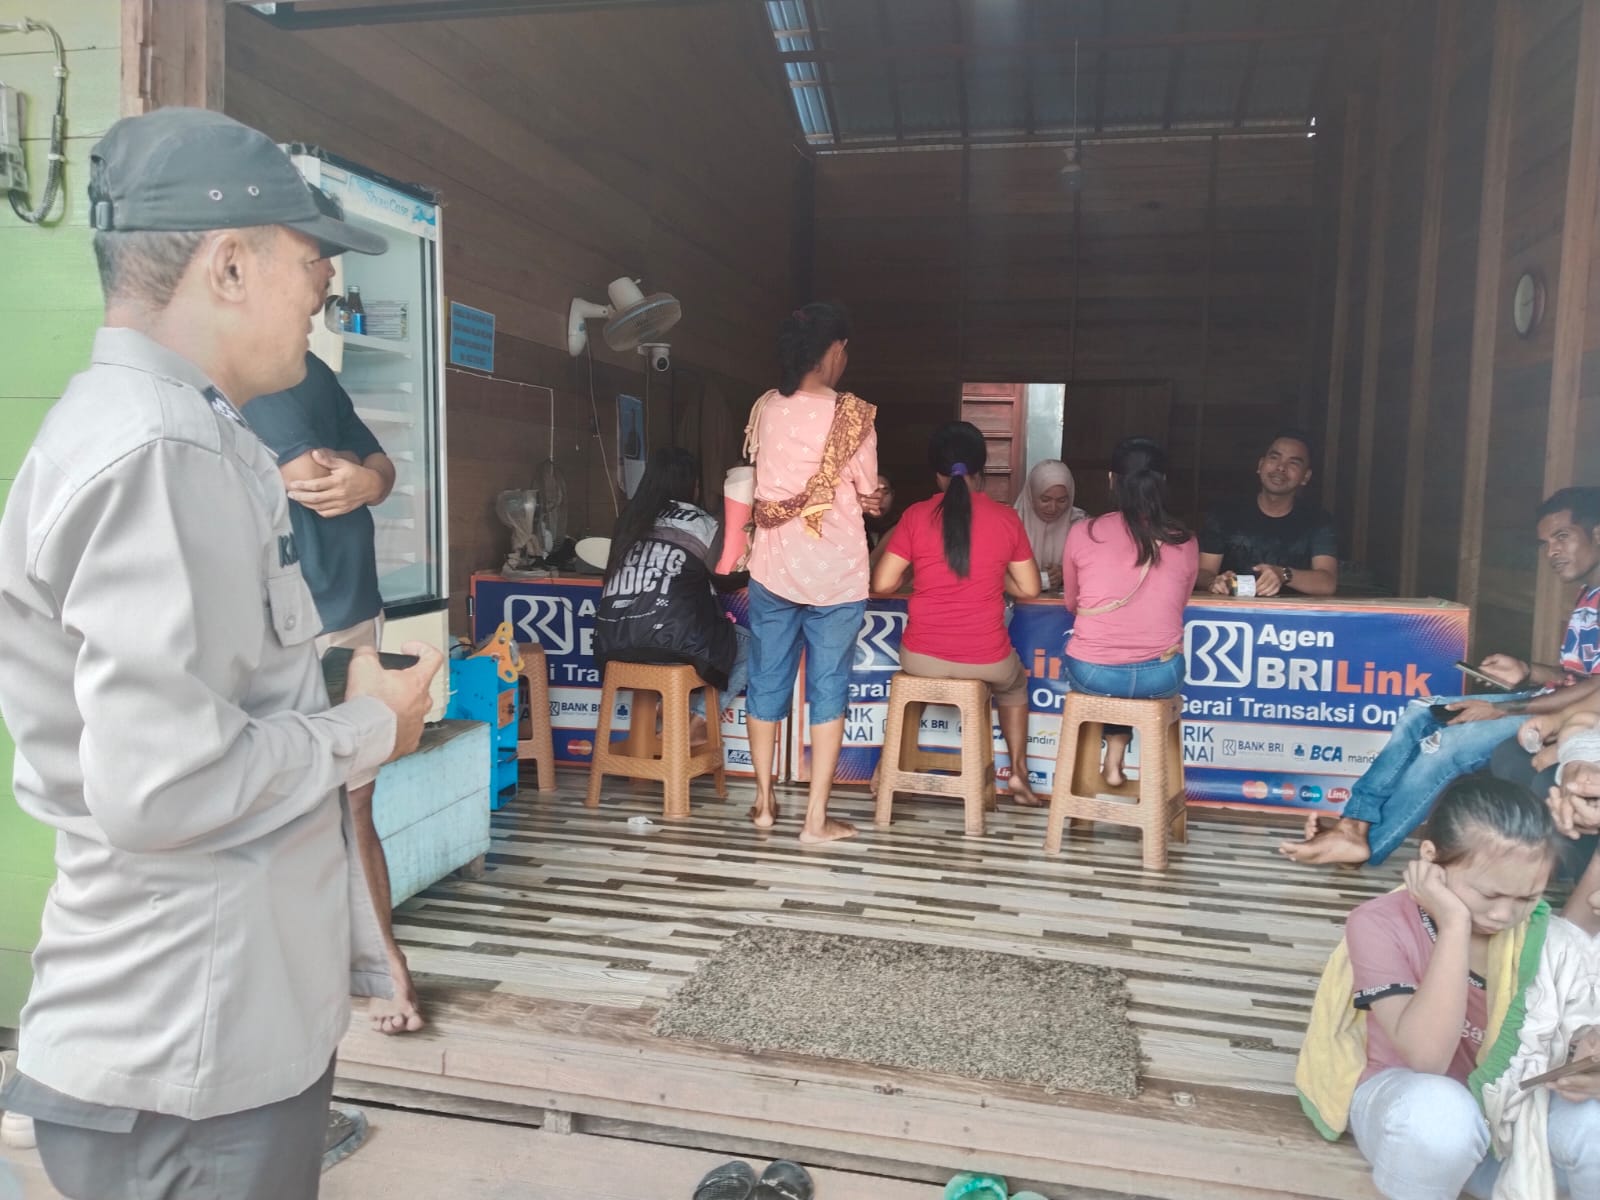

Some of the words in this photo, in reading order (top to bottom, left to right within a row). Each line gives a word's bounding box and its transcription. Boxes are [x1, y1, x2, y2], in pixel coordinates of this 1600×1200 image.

[624, 540, 687, 572] CING
[602, 567, 682, 598] DDICT
[1257, 624, 1335, 651] Agen
[563, 664, 600, 682] Tra
[1257, 657, 1432, 697] BRILink
[848, 680, 891, 698] erai
[561, 703, 589, 713] BANK
[845, 708, 873, 723] RIK
[1239, 697, 1355, 723] Transaksi
[1362, 704, 1405, 726] Onl
[844, 725, 873, 741] NAI
[931, 719, 949, 730] BRI
[1184, 725, 1215, 743] RIK
[1184, 745, 1214, 763] NAI
[1238, 740, 1264, 752] BANK
[1268, 743, 1285, 753] BRI
[1310, 745, 1343, 762] BCA
[1327, 788, 1349, 801] Link
